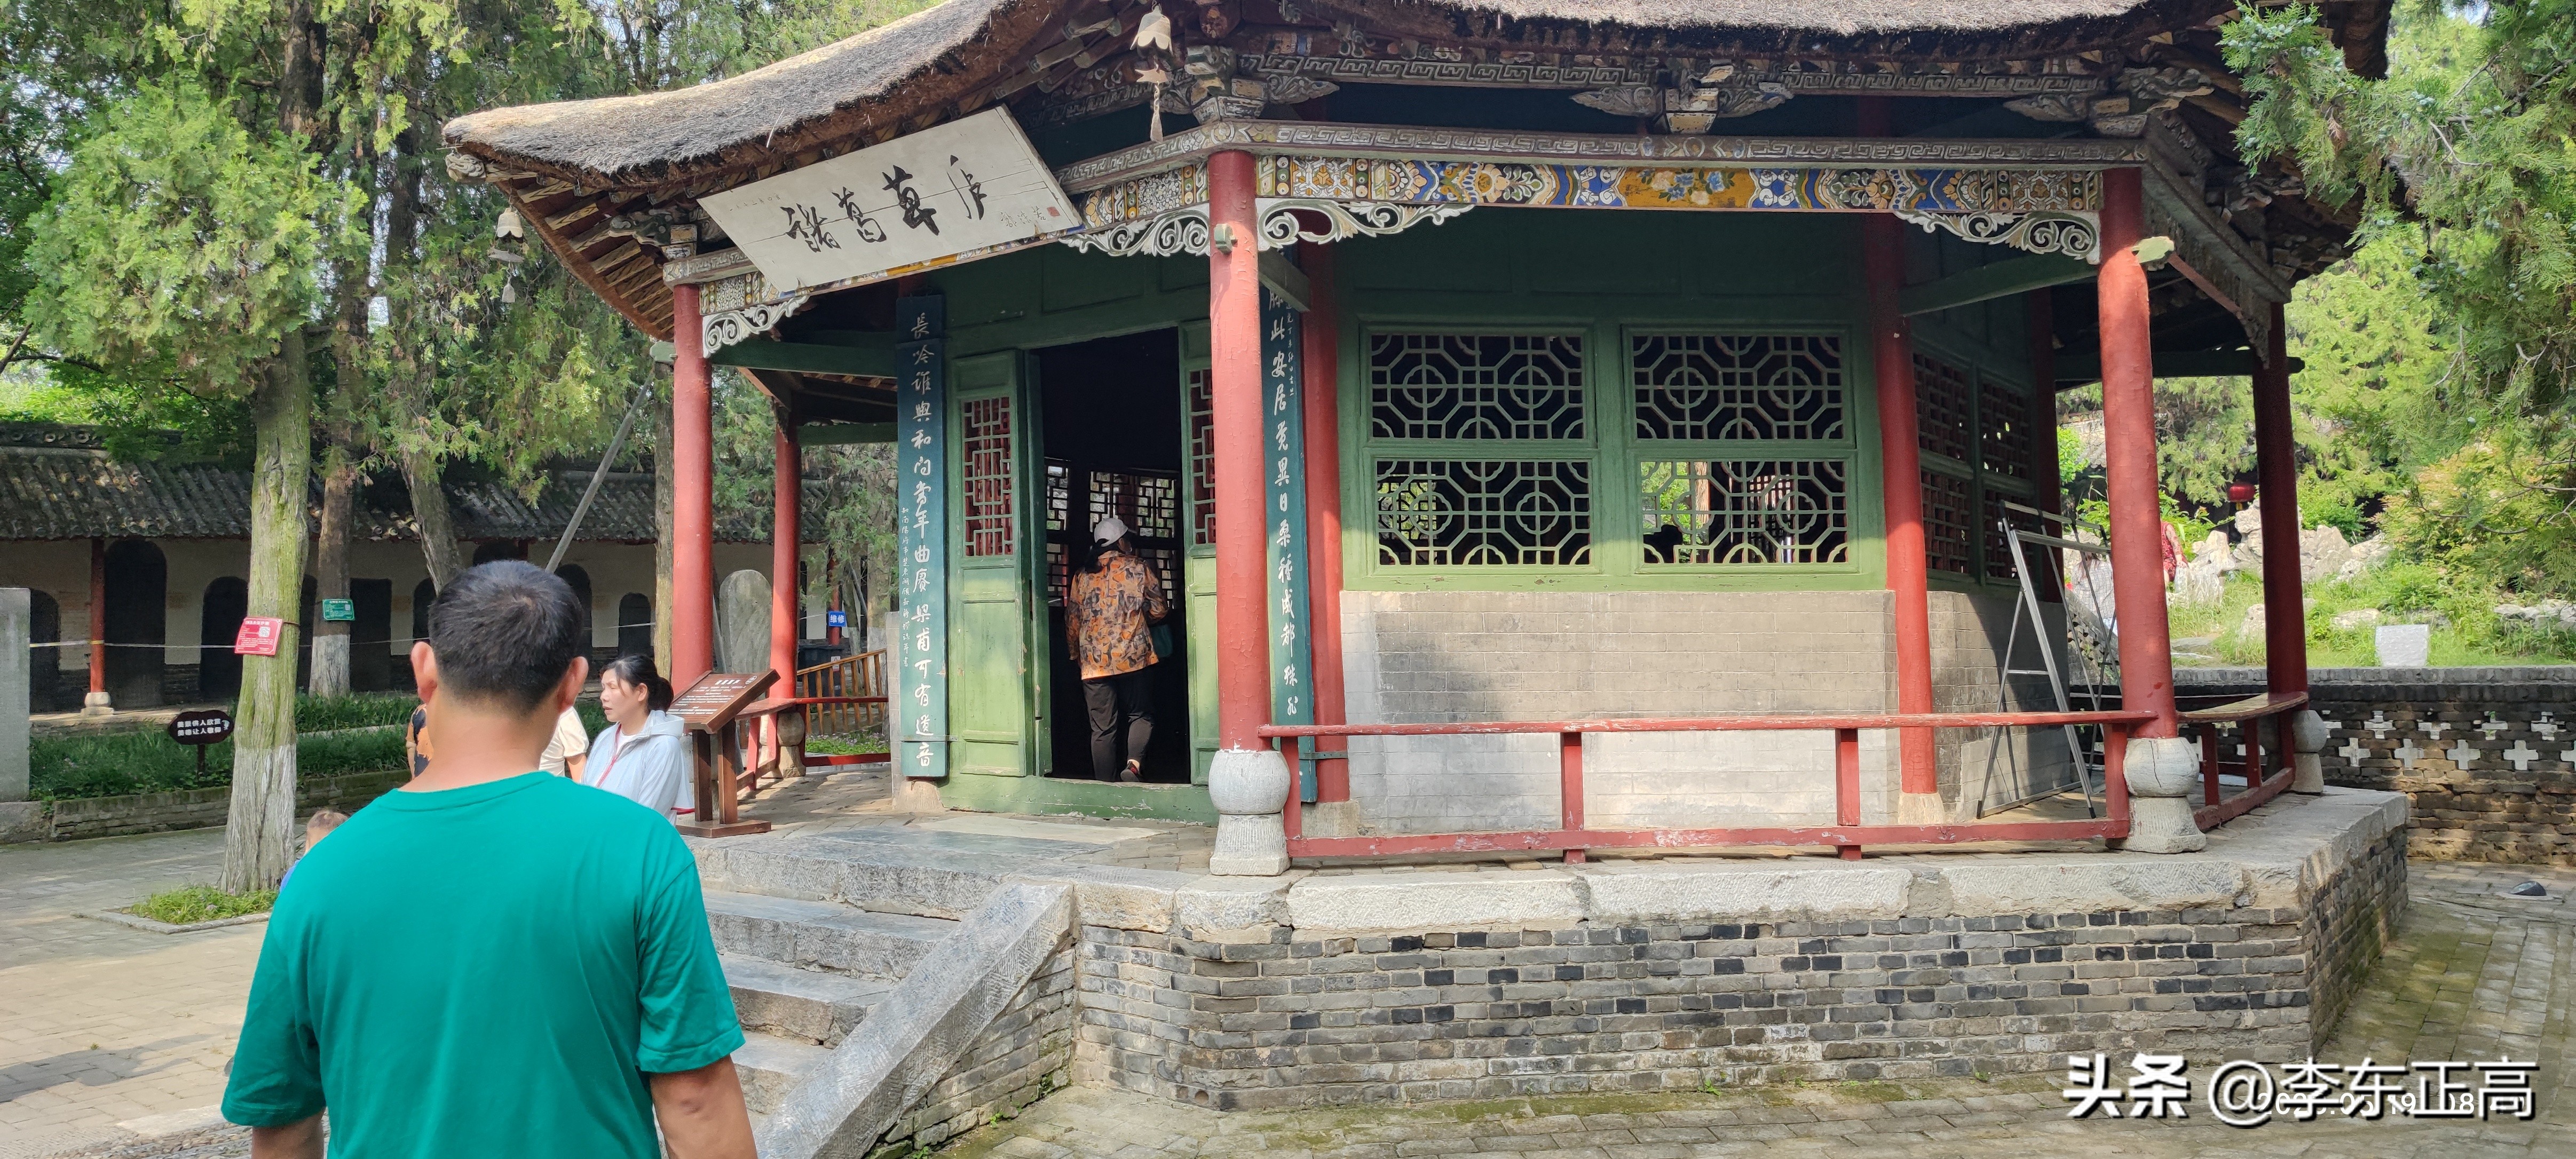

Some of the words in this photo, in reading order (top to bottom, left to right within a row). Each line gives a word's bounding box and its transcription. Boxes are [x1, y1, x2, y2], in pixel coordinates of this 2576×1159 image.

[1000, 205, 1046, 228] 郭沫若
[829, 614, 846, 624] 维修
